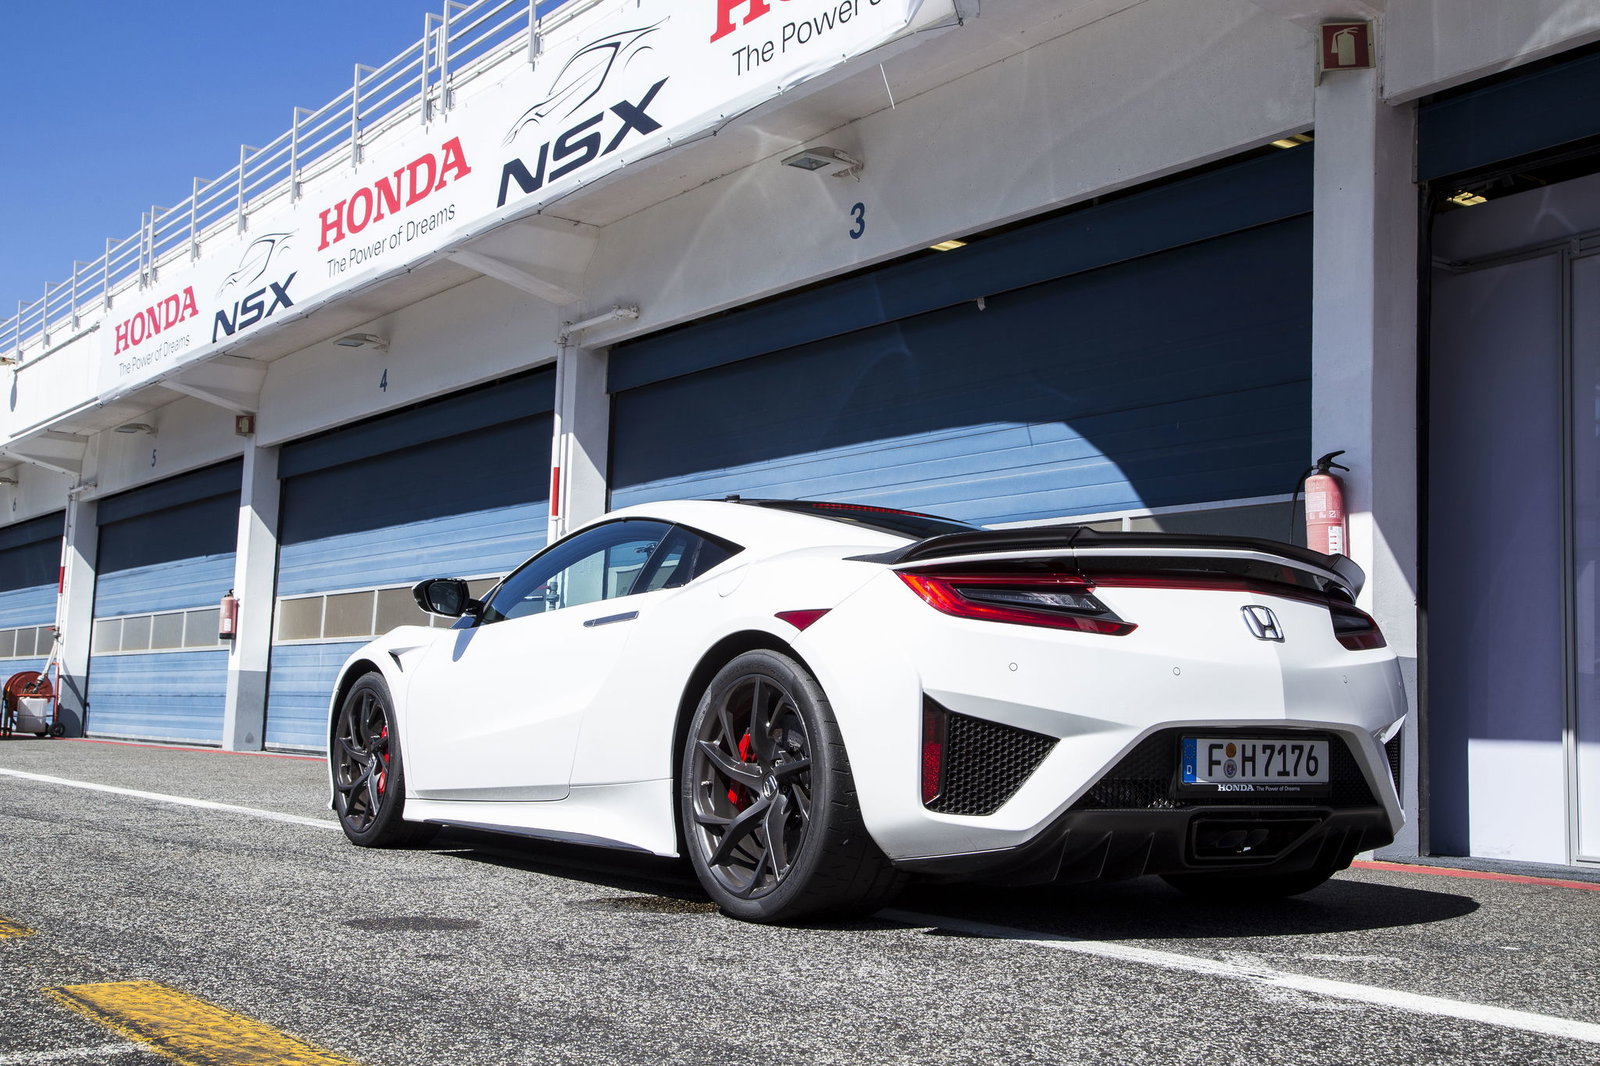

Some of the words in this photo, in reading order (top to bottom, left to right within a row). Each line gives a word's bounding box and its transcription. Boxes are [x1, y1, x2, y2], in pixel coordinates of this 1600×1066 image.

[732, 40, 774, 76] The
[496, 75, 671, 208] NSX
[317, 136, 472, 251] HONDA
[849, 202, 866, 240] 3
[327, 258, 346, 278] The
[349, 238, 387, 268] Power
[389, 225, 403, 249] of
[406, 203, 455, 242] Dreams
[114, 285, 199, 356] HONDA
[212, 271, 298, 344] NSX
[379, 368, 388, 393] 4
[151, 448, 157, 468] 5
[1186, 765, 1192, 775] D
[1217, 784, 1254, 792] HONDA
